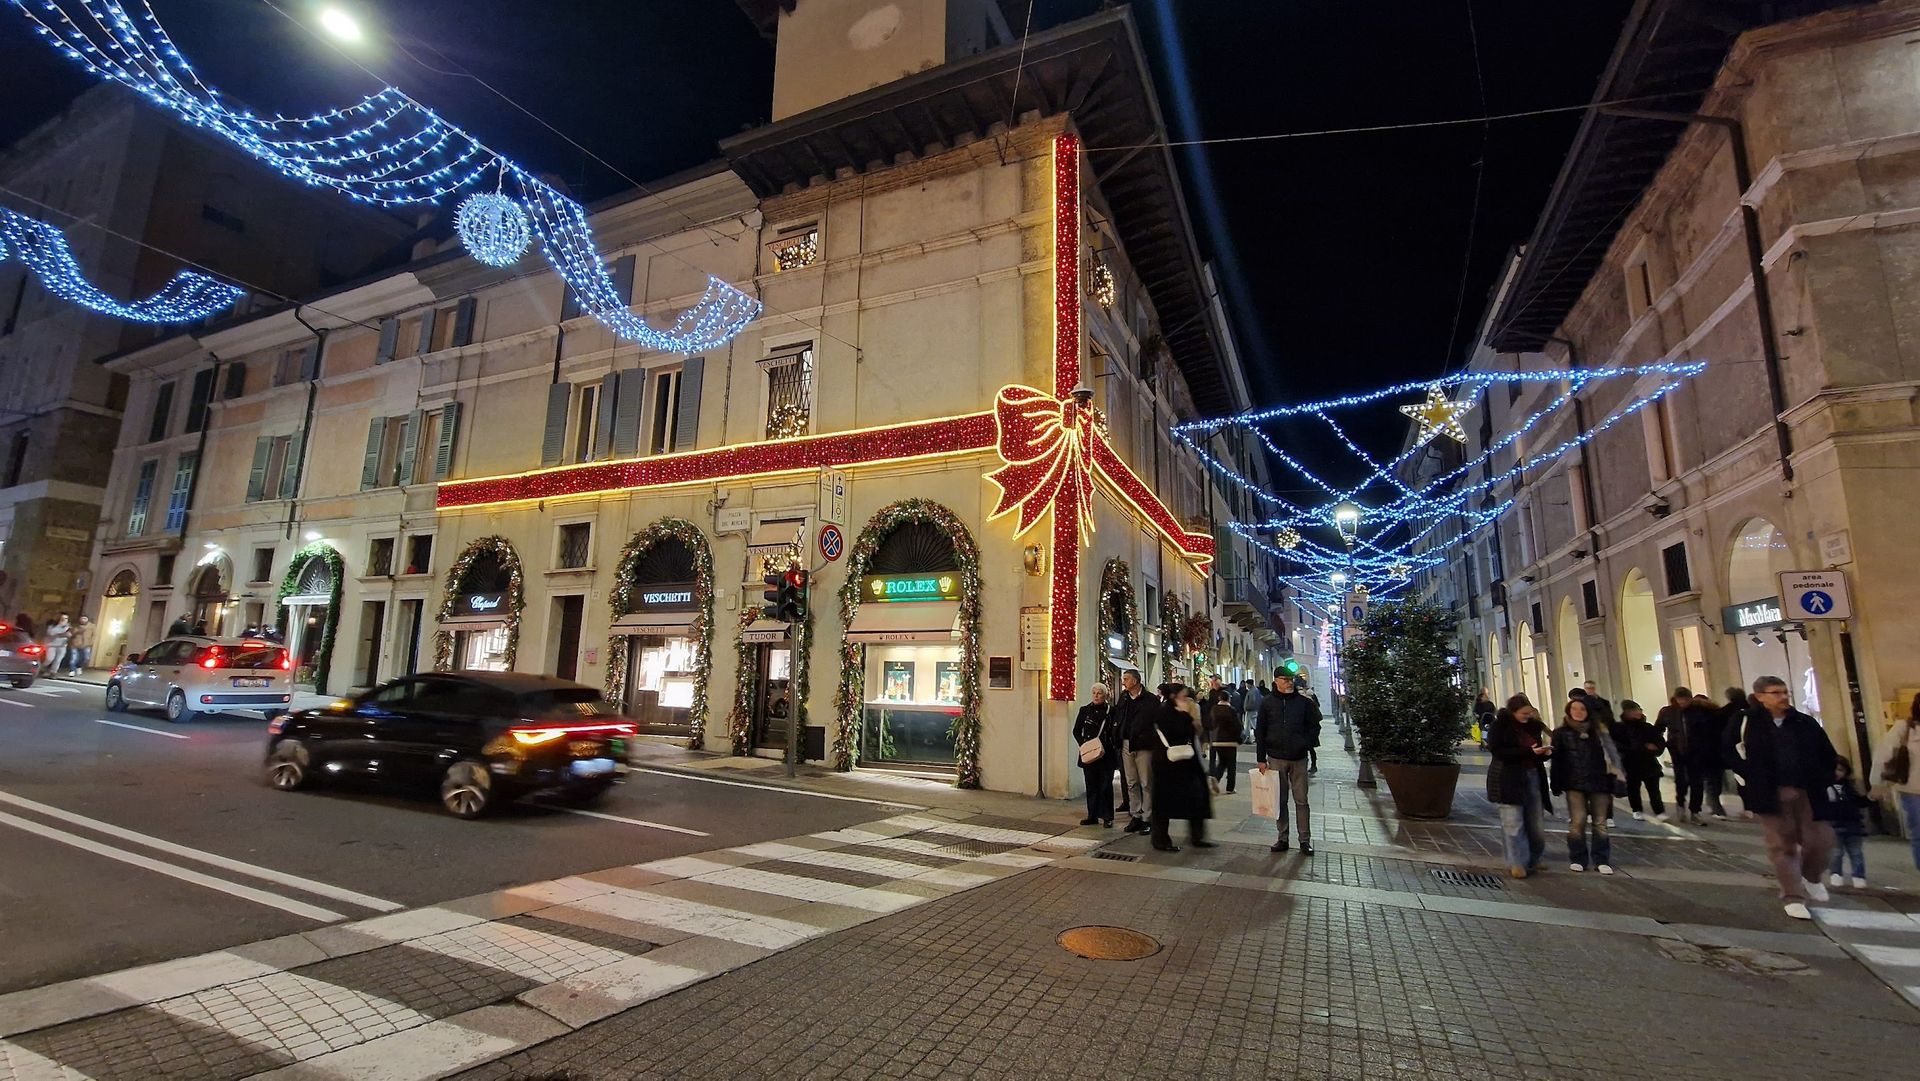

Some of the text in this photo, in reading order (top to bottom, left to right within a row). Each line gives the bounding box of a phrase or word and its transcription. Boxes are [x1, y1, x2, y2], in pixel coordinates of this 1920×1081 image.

[749, 546, 787, 554] VESCHETTI
[885, 579, 936, 594] ROLEX
[1793, 581, 1835, 589] pedonale
[643, 591, 691, 604] VESCHETTI
[1738, 603, 1782, 627] MaxMara
[632, 626, 666, 634] VESCHETTI
[749, 632, 777, 640] TUDOR
